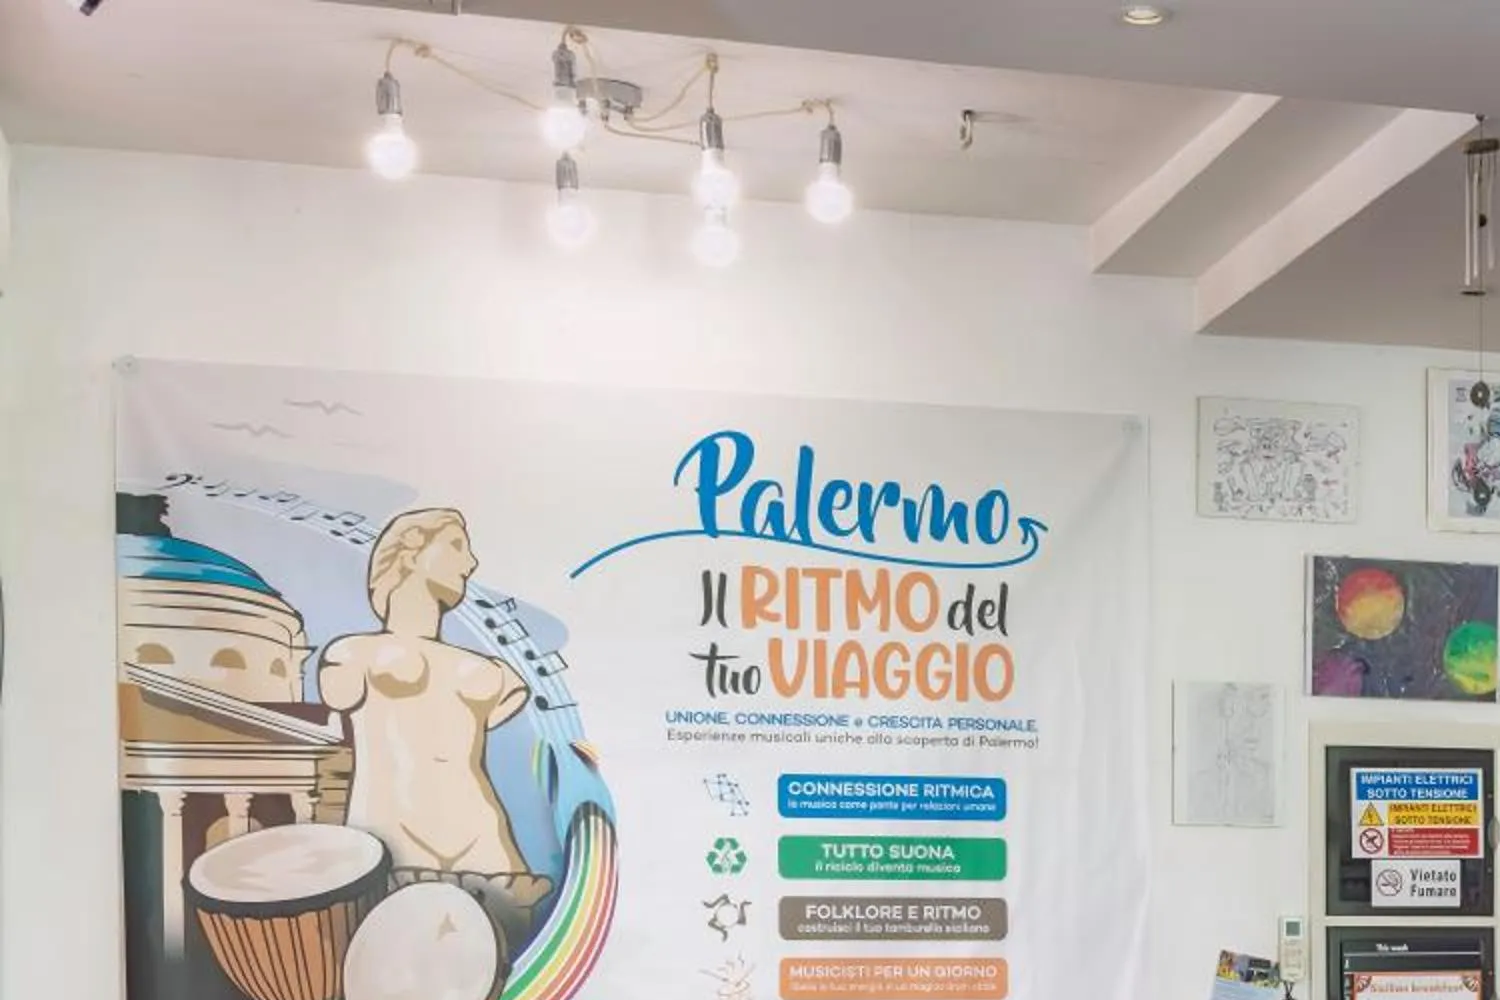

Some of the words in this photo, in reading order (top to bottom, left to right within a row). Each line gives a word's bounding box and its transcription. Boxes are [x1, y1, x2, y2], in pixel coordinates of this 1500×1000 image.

[674, 430, 1010, 545] Palermo
[700, 570, 728, 627] Il
[740, 564, 941, 633] RITMO
[947, 583, 1009, 636] del
[690, 643, 762, 698] tuo
[768, 638, 1014, 701] VIAGGIO
[735, 713, 849, 727] CONNESSIONE
[868, 715, 944, 730] CRESCITA
[667, 729, 746, 743] Esperienze
[751, 731, 811, 744] musicali
[815, 732, 863, 746] uniche
[867, 733, 893, 745] alla
[897, 735, 959, 749] scoperta
[963, 736, 976, 747] di
[980, 735, 1040, 749] Palermo!
[1361, 775, 1411, 785] IMPIANTI
[1415, 776, 1473, 785] ELETTRICI
[788, 781, 918, 797] CONNESSIONE
[923, 783, 995, 798] RITMICA
[1368, 788, 1408, 799] SOTTO
[1410, 788, 1469, 799] TENSIONE
[800, 800, 837, 809] musica
[821, 843, 883, 858] TUTTO
[888, 844, 954, 859] SUONA
[866, 862, 914, 874] diventa
[917, 863, 961, 874] musica
[1410, 869, 1457, 883] Vietato
[1410, 885, 1457, 898] Fumare
[805, 904, 903, 919] FOLKLORE
[908, 905, 919, 919] E
[923, 905, 981, 920] RITMO
[790, 965, 870, 977] MUSICISTI
[874, 965, 903, 978] PER
[907, 965, 931, 978] UN
[935, 965, 997, 978] GIORNO
